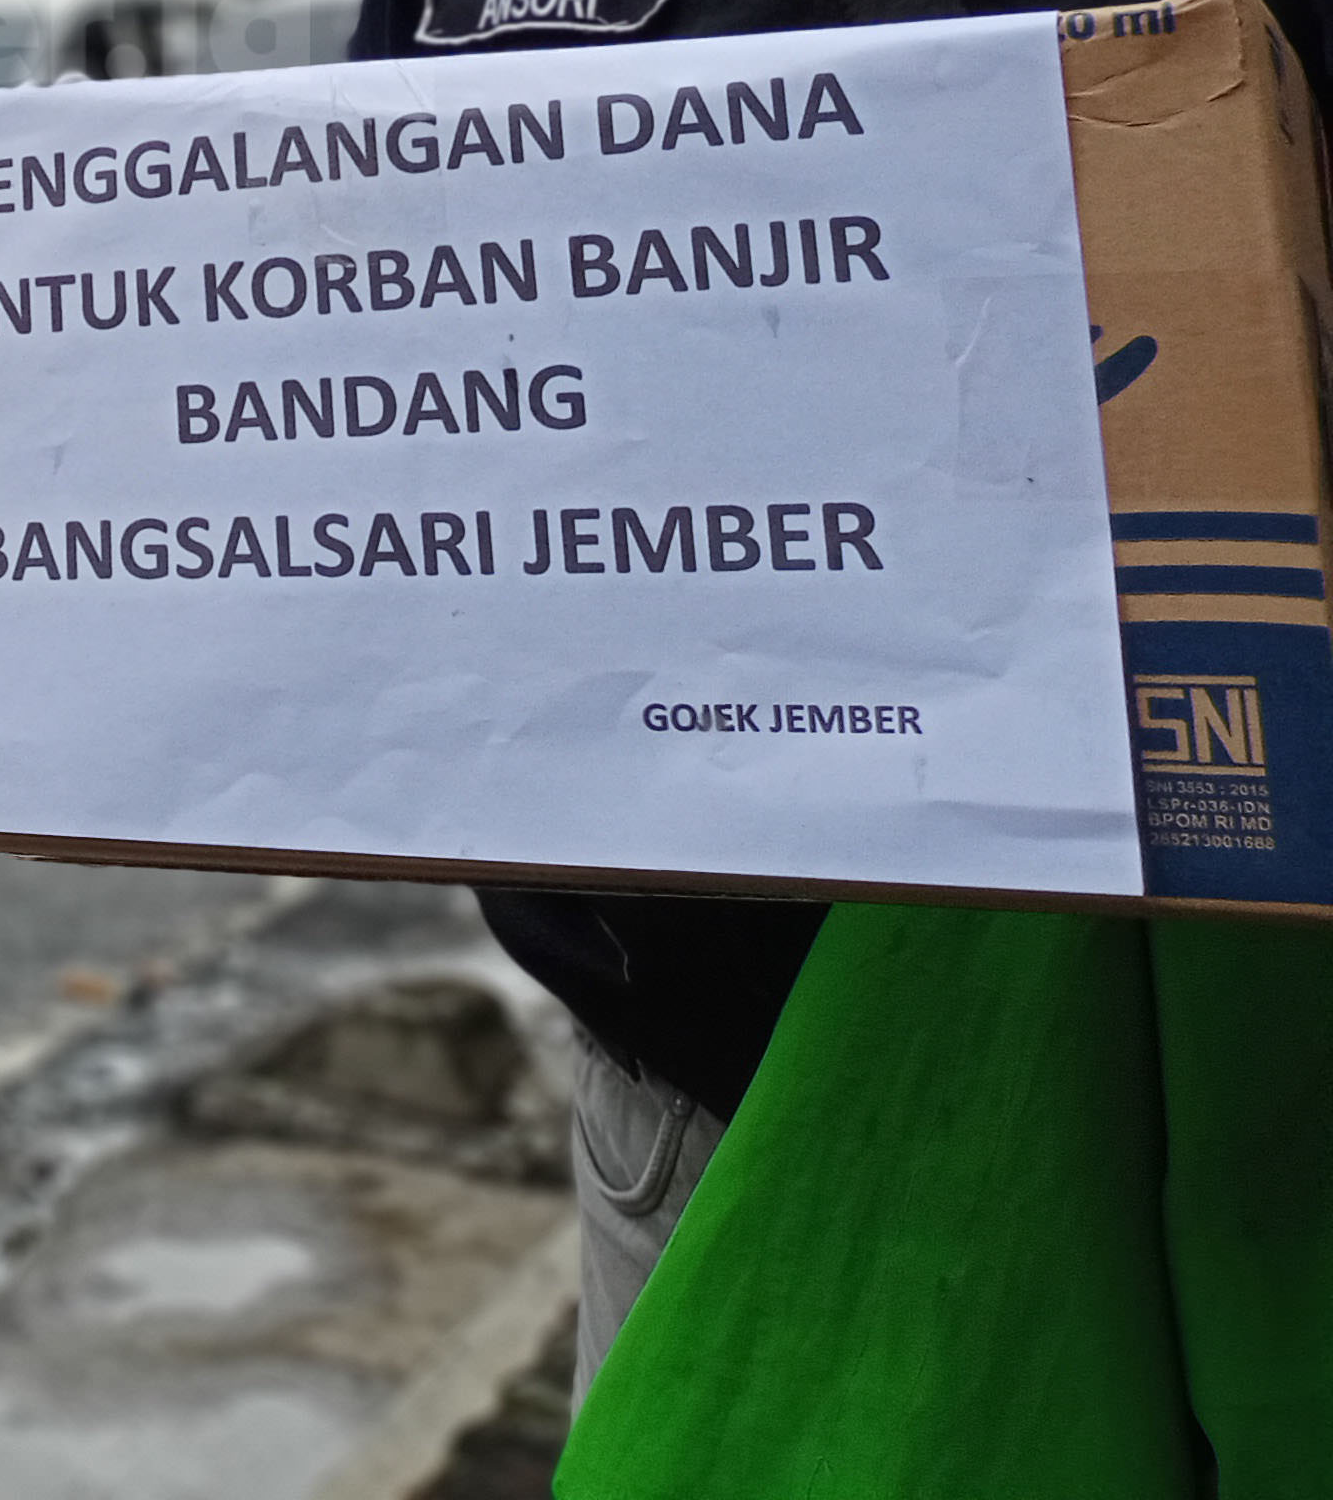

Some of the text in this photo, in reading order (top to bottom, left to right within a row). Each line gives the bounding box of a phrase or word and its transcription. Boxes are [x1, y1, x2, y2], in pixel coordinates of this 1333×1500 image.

[1113, 1, 1176, 37] ml
[596, 71, 866, 157] DANA
[202, 237, 539, 324] KORBAN
[567, 214, 892, 300] BANJIR
[175, 363, 588, 446] BANDANG
[522, 501, 885, 577] JEMBER
[641, 703, 924, 735] GOJEK JEMBER
[1135, 686, 1266, 766] SNI
[1146, 780, 1172, 793] SNI
[1229, 783, 1270, 797] 2015
[1148, 812, 1272, 831] BPOM RI MD
